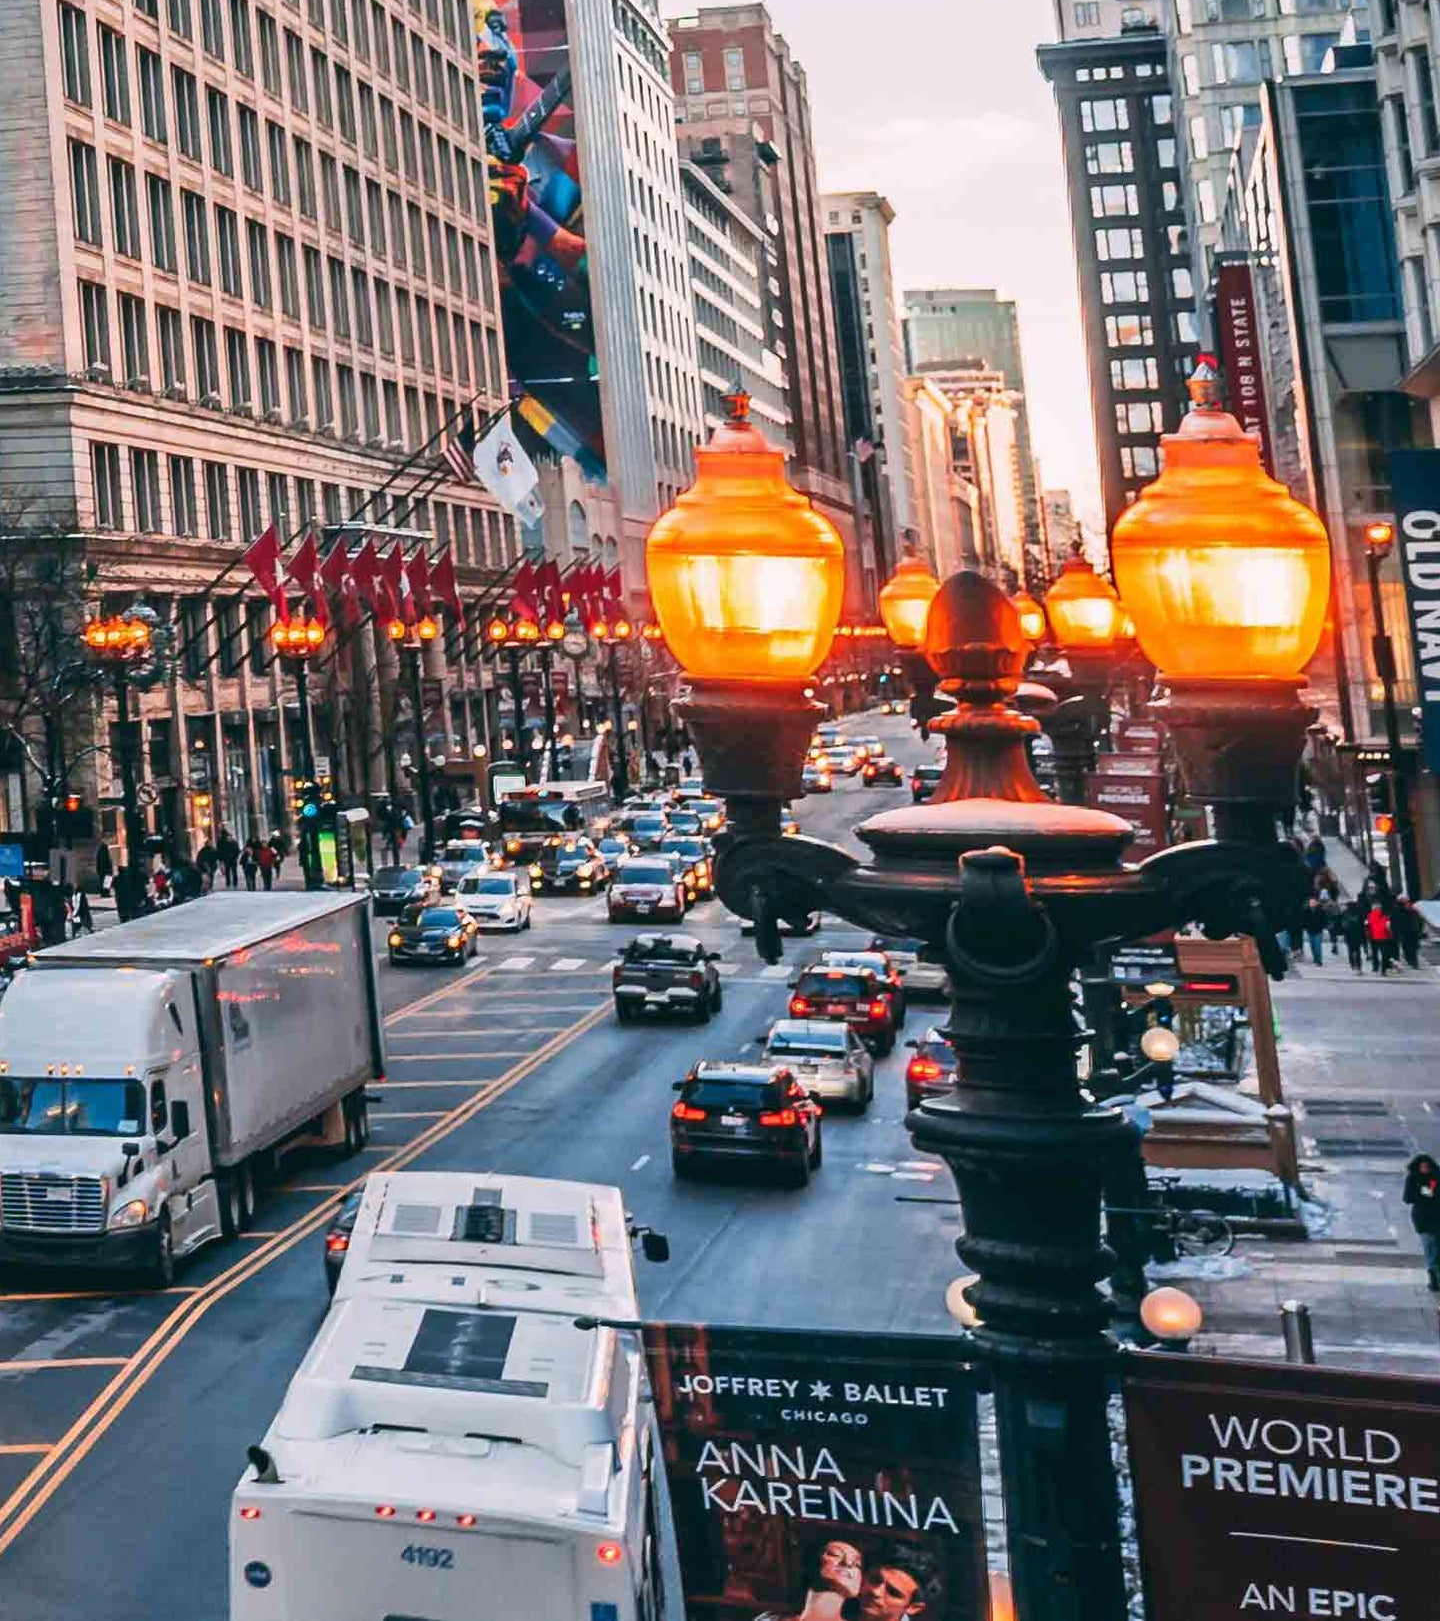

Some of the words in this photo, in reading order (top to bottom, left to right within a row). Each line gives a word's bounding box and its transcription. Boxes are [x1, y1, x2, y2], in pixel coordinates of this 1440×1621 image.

[1231, 298, 1250, 347] STATE
[1239, 356, 1252, 367] N
[1241, 375, 1257, 405] 108
[1402, 510, 1440, 590] OLD
[678, 1374, 799, 1399] JOFFREY
[844, 1382, 949, 1408] BALLET
[781, 1409, 868, 1425] CHICAGO
[1209, 1413, 1401, 1464] WORLD
[696, 1440, 846, 1483] ANNA
[1181, 1454, 1440, 1513] PREMIERE
[700, 1477, 960, 1534] KARENINA
[401, 1544, 454, 1570] 4192
[1239, 1583, 1295, 1613] AN
[1308, 1587, 1397, 1621] EPIC
